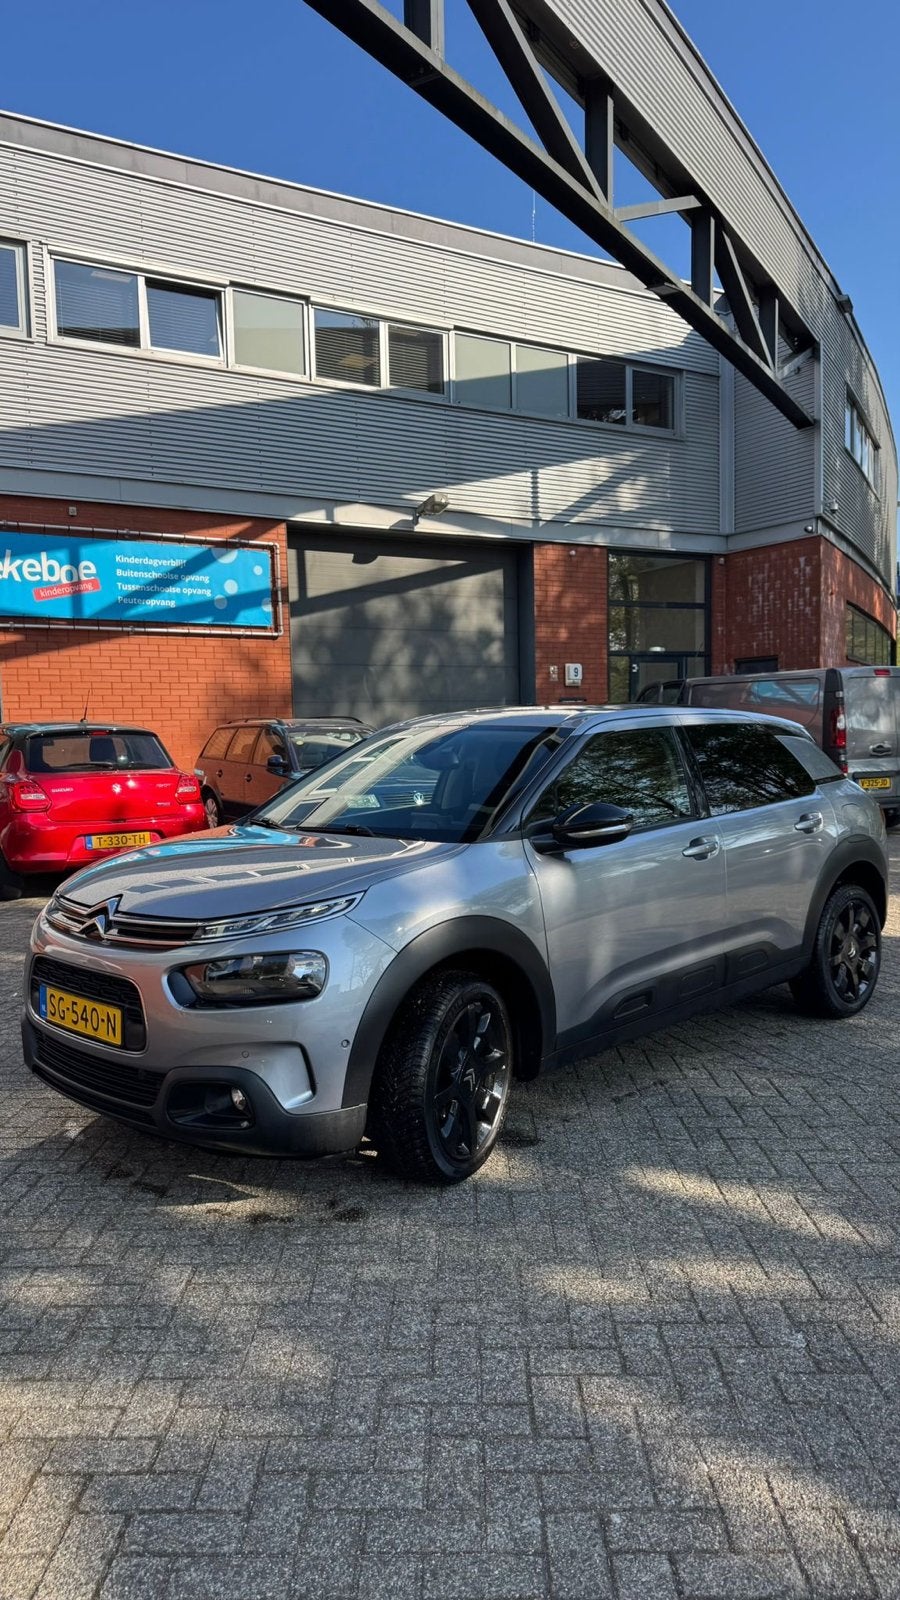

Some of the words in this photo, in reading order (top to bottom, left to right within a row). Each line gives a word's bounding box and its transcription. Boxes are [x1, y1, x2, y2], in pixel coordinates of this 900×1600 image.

[0, 549, 97, 584] keboe
[115, 555, 187, 568] Kinderdagverblijf
[116, 568, 179, 580] Buitenschoolse
[180, 574, 210, 584] opvang
[39, 582, 93, 598] kinderopvang
[117, 582, 181, 594] Tussenschoolse
[182, 588, 212, 597] opvang
[117, 596, 176, 608] Peuteropvang
[573, 667, 579, 677] 9
[96, 833, 146, 847] T-330-TH
[48, 993, 117, 1038] SG-540-N
